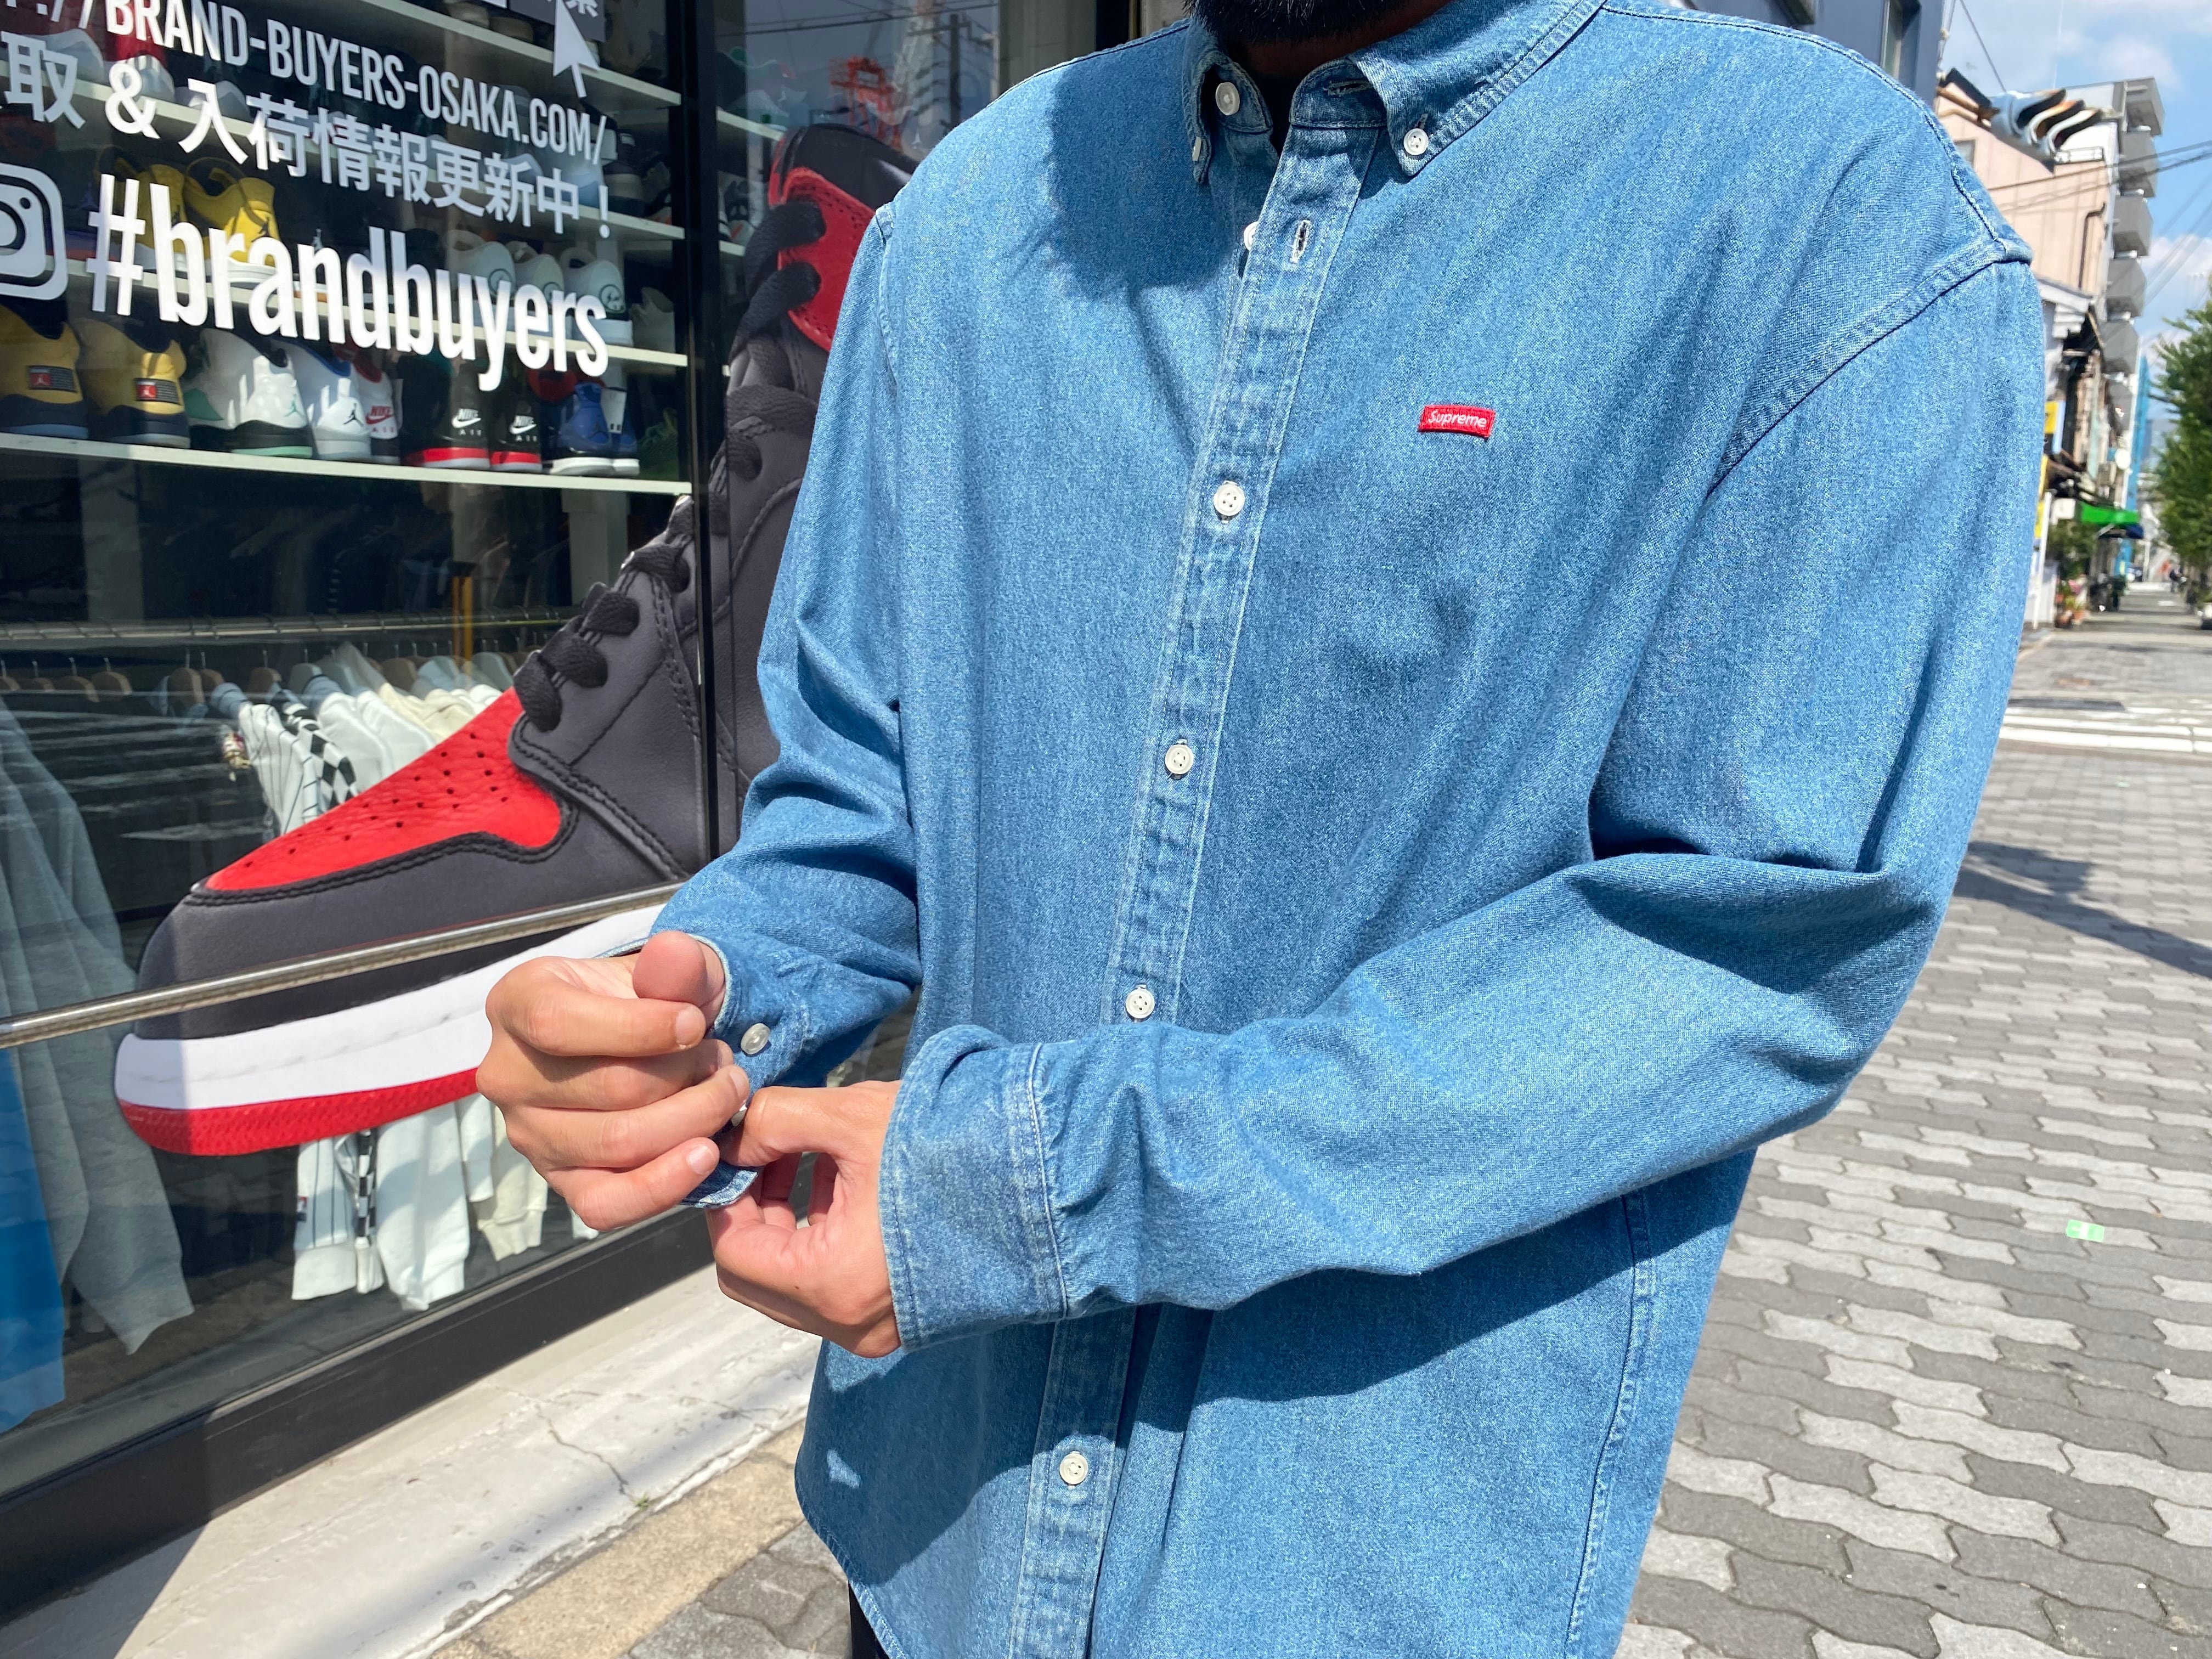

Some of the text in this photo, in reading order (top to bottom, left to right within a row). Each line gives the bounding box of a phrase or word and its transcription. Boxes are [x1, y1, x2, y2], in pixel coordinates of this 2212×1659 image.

[105, 63, 160, 138] &
[86, 173, 609, 391] #brandbuyers
[458, 408, 479, 420] NIKE
[514, 415, 534, 427] NIKE
[1427, 410, 1487, 428] Supreme
